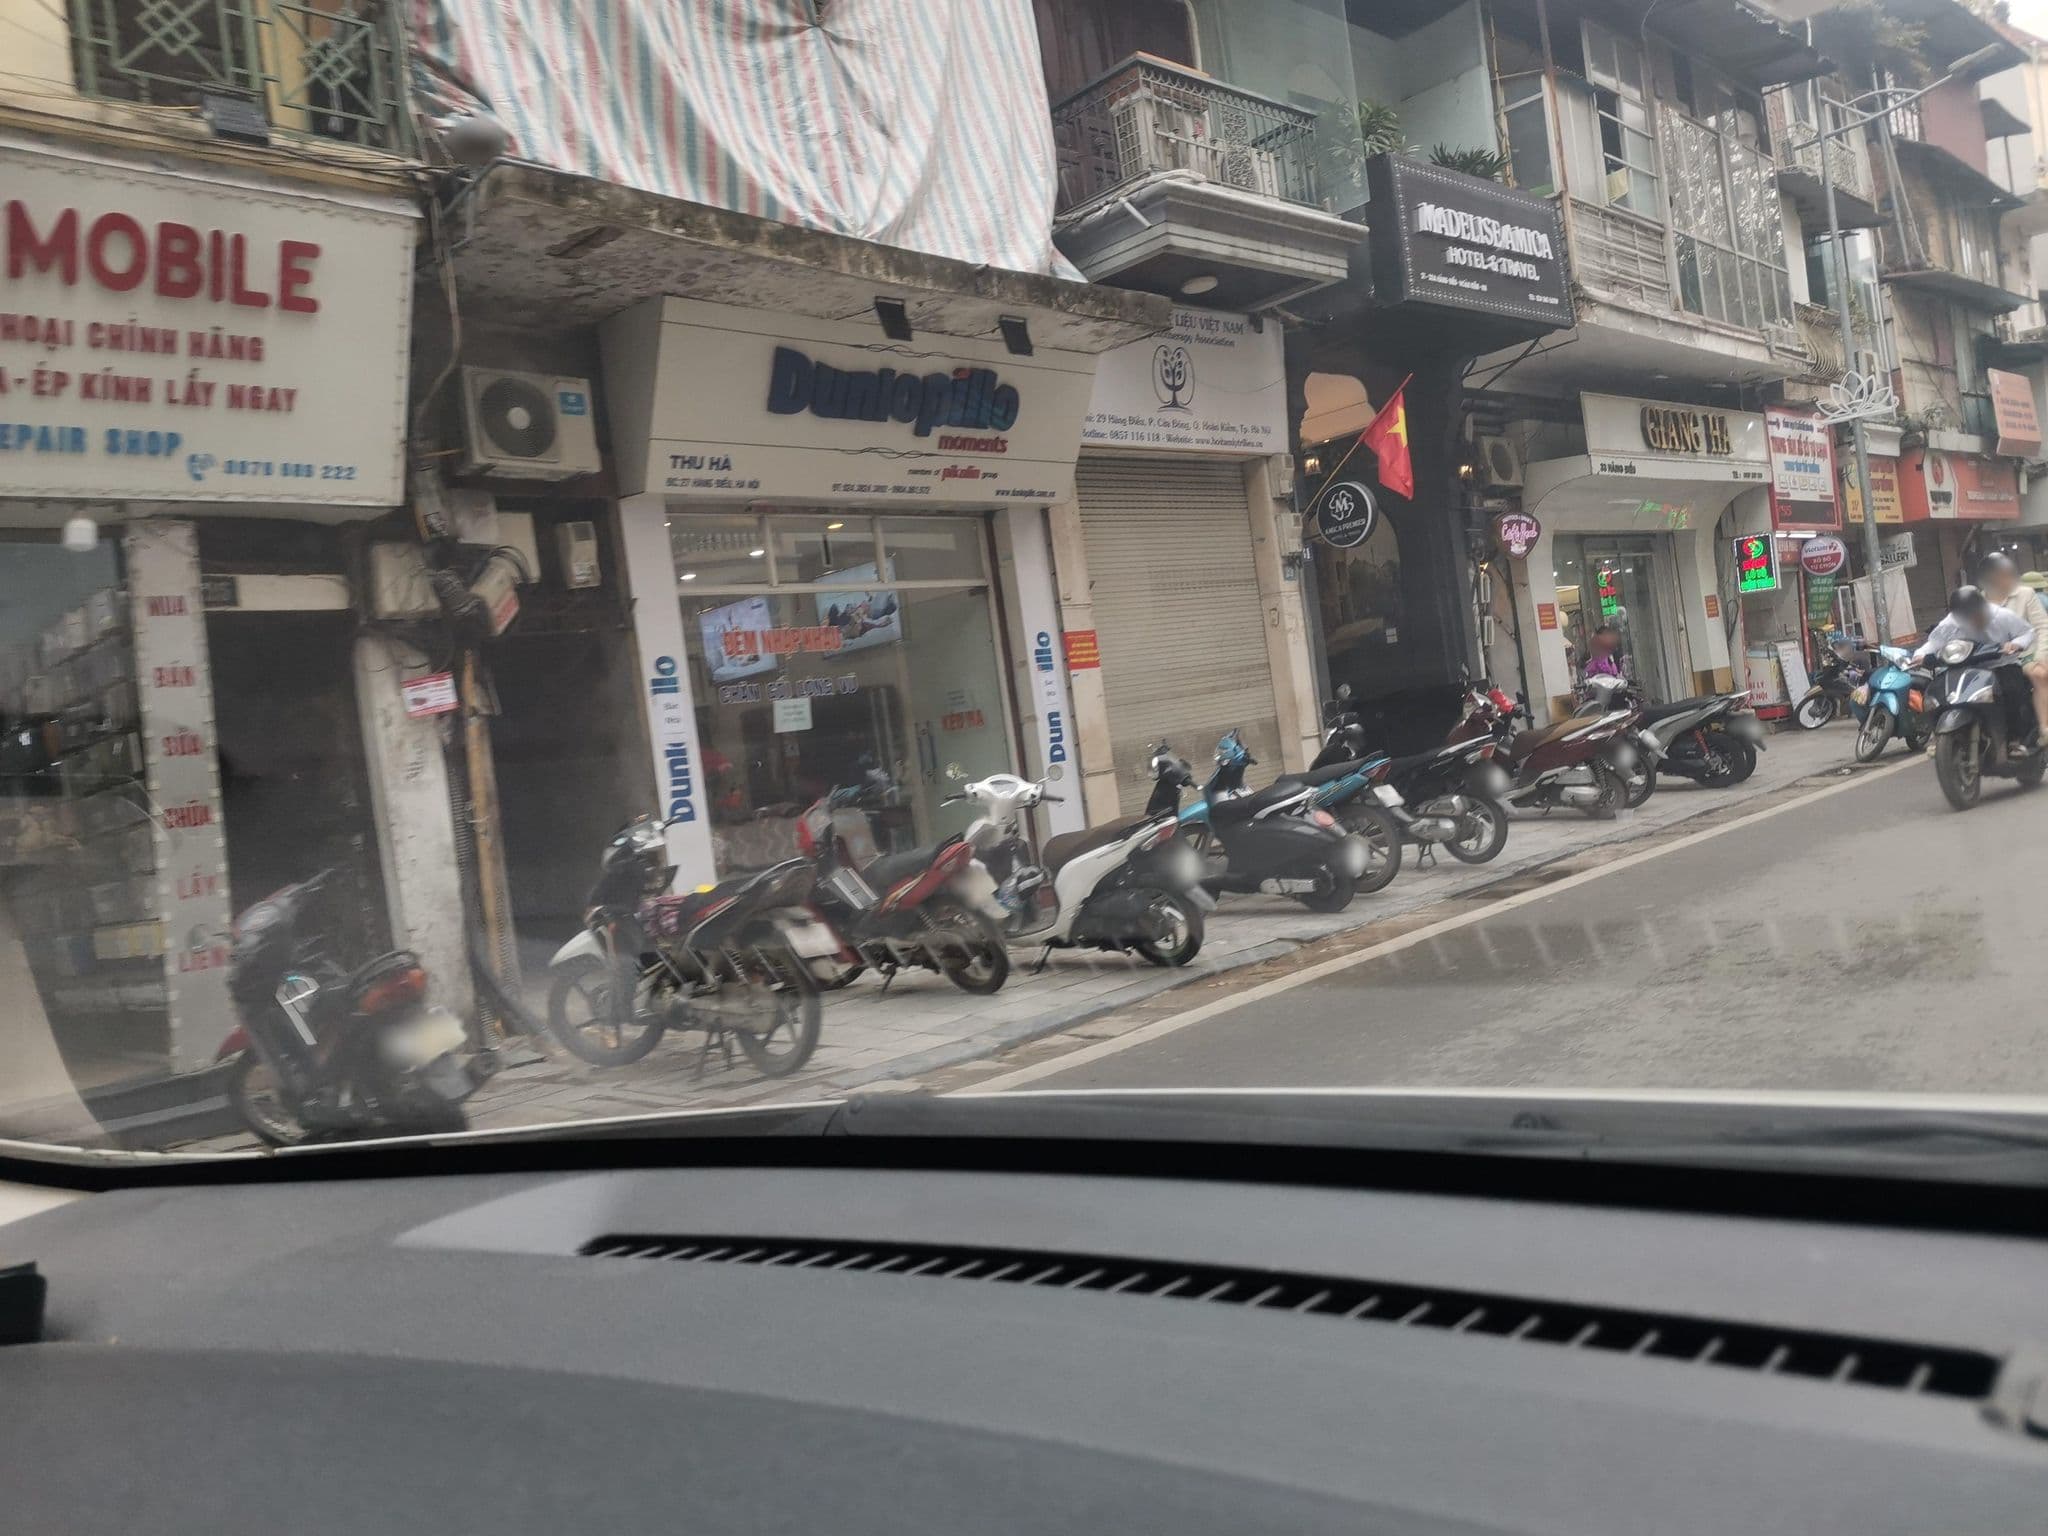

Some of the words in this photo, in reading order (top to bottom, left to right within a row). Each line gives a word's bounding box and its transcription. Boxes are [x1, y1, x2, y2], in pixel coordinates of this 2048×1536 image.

[7, 199, 321, 313] MOBILE
[1445, 246, 1487, 270] HOTEL
[1499, 257, 1540, 281] TRAVEL
[226, 383, 298, 413] NGAY
[767, 345, 1020, 437] Dunlopillo
[104, 428, 183, 456] SHOP
[1640, 405, 1700, 452] GIANG
[937, 434, 1009, 454] moments
[320, 465, 358, 480] 222
[669, 455, 704, 470] THU
